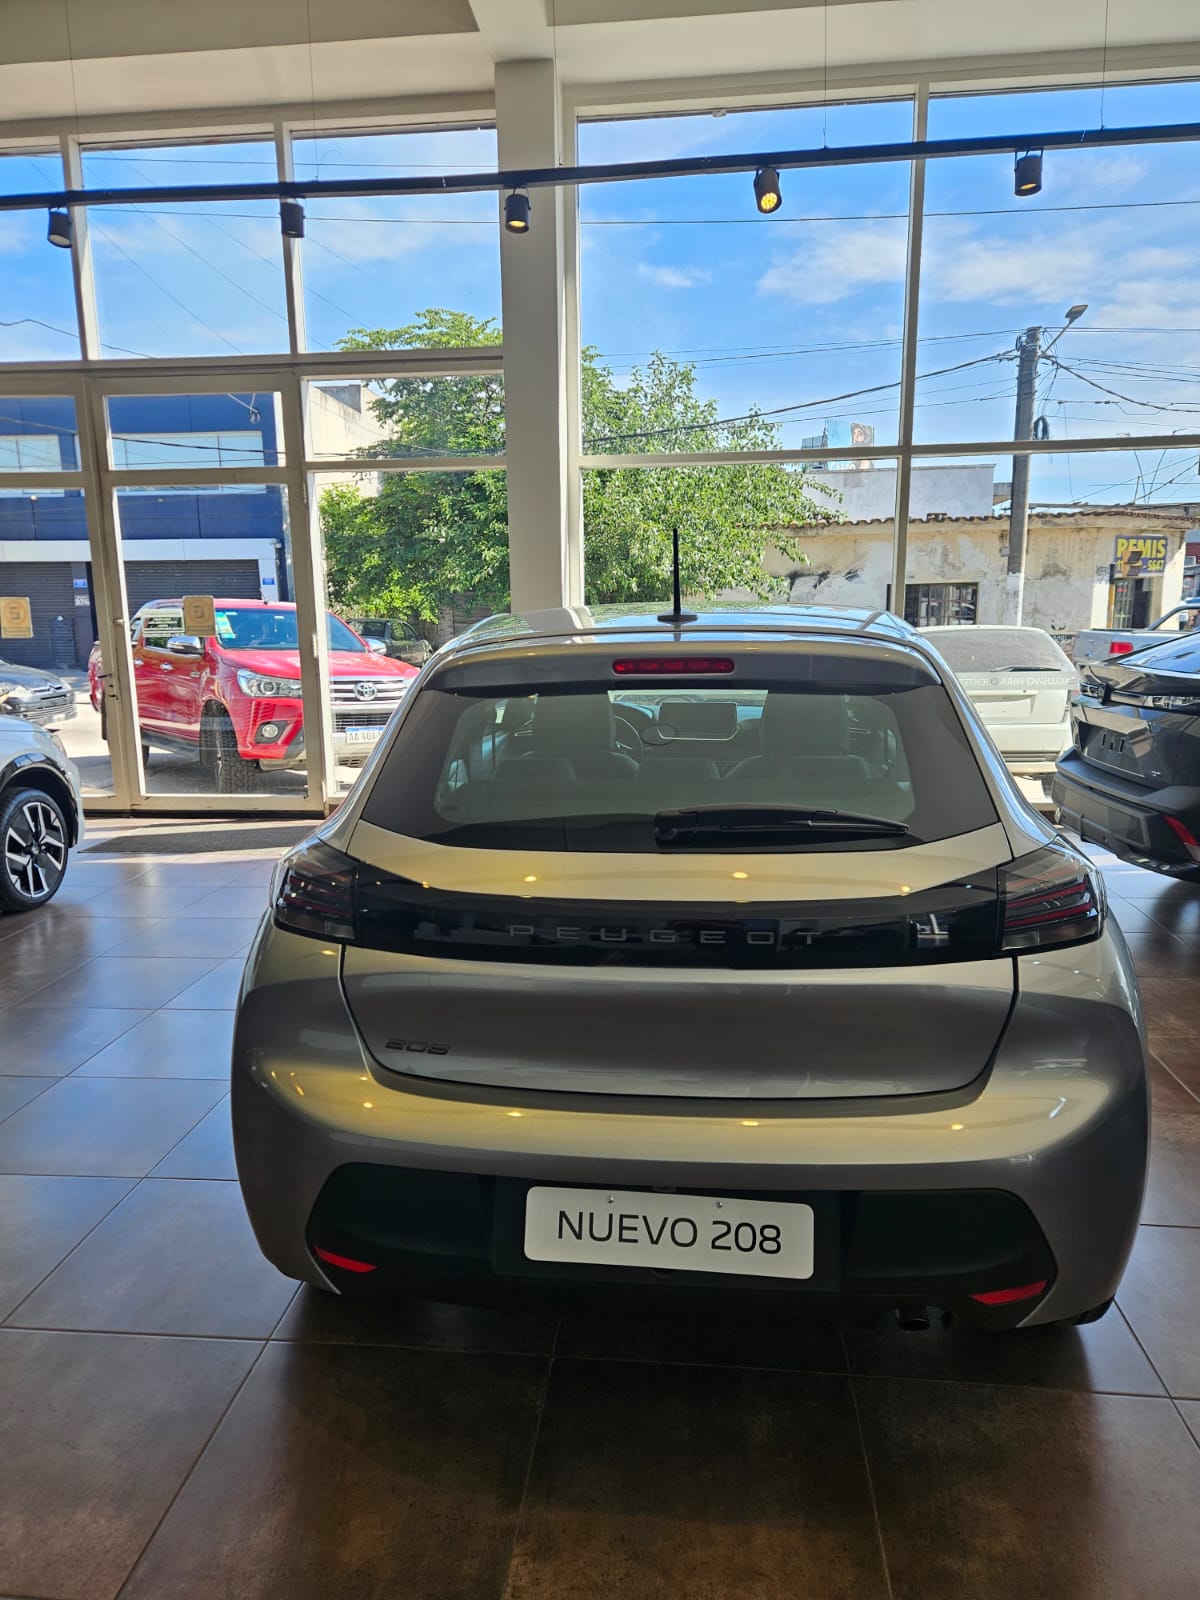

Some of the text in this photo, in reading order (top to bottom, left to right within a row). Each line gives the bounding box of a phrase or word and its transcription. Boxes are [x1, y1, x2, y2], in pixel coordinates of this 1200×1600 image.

[1117, 538, 1166, 558] REMIS
[508, 924, 822, 945] PEUGEOT
[384, 1038, 450, 1055] 208
[557, 1210, 782, 1255] NUEVO 208
